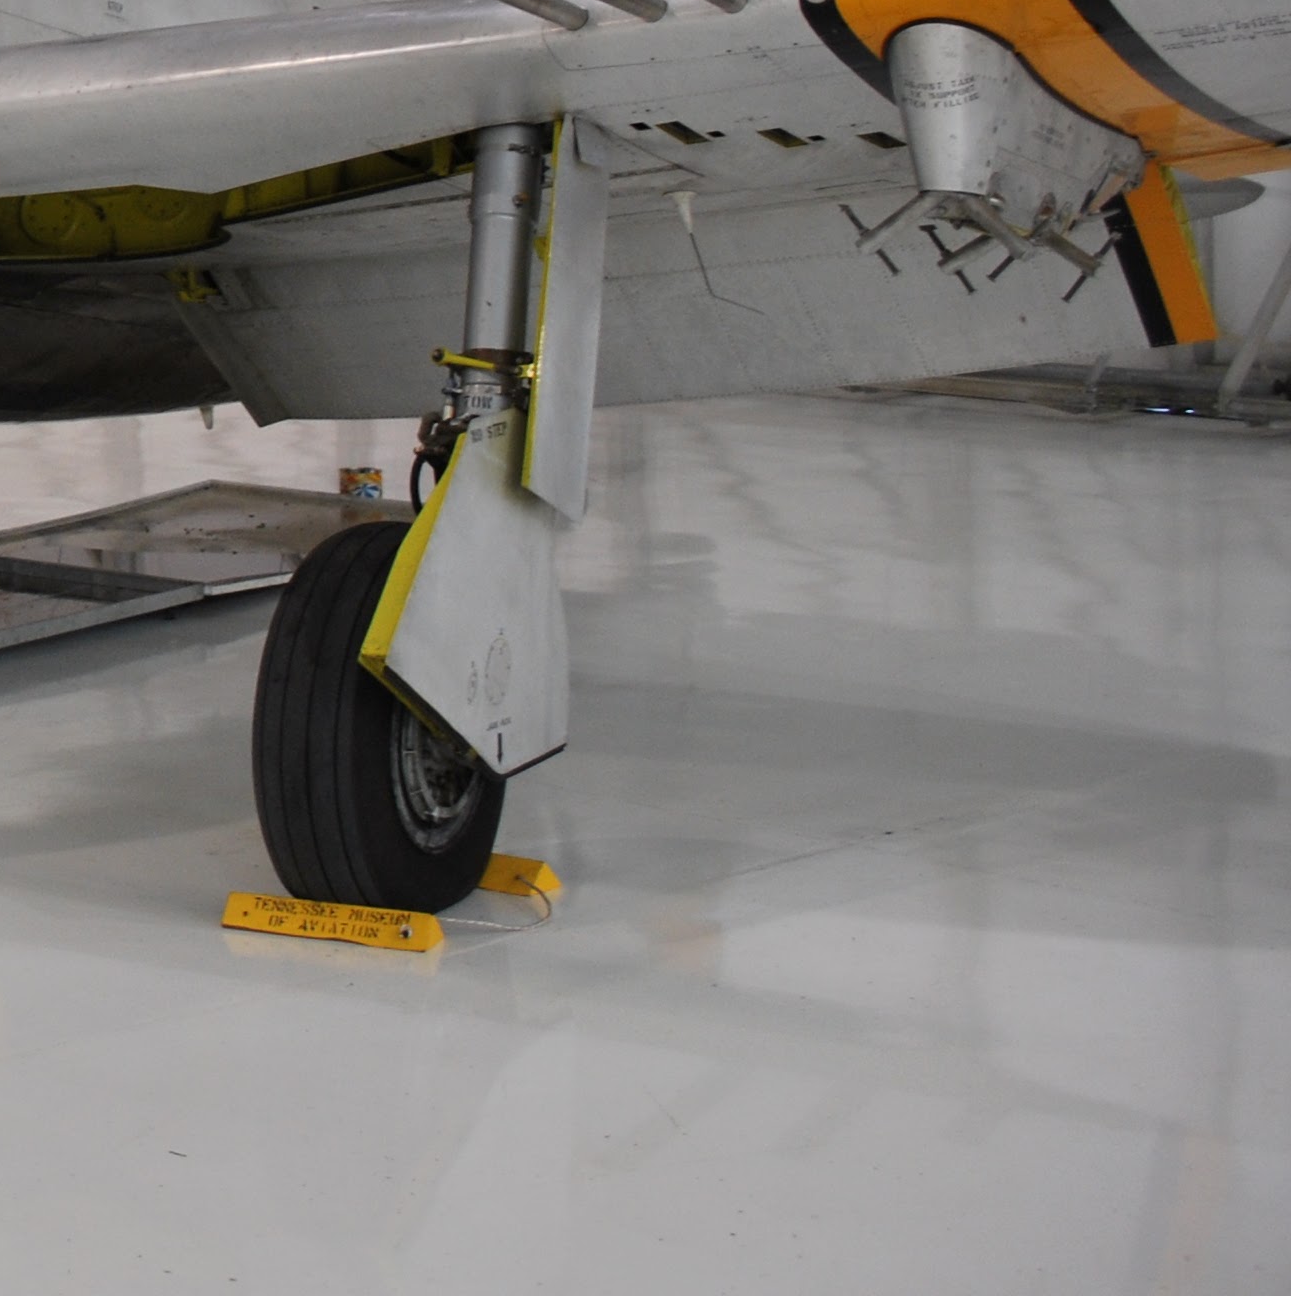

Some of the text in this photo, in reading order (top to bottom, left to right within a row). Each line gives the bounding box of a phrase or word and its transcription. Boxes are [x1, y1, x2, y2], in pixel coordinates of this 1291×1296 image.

[254, 896, 411, 926] TENNESSEE MUSEUM
[268, 915, 379, 938] OF AVIATION
